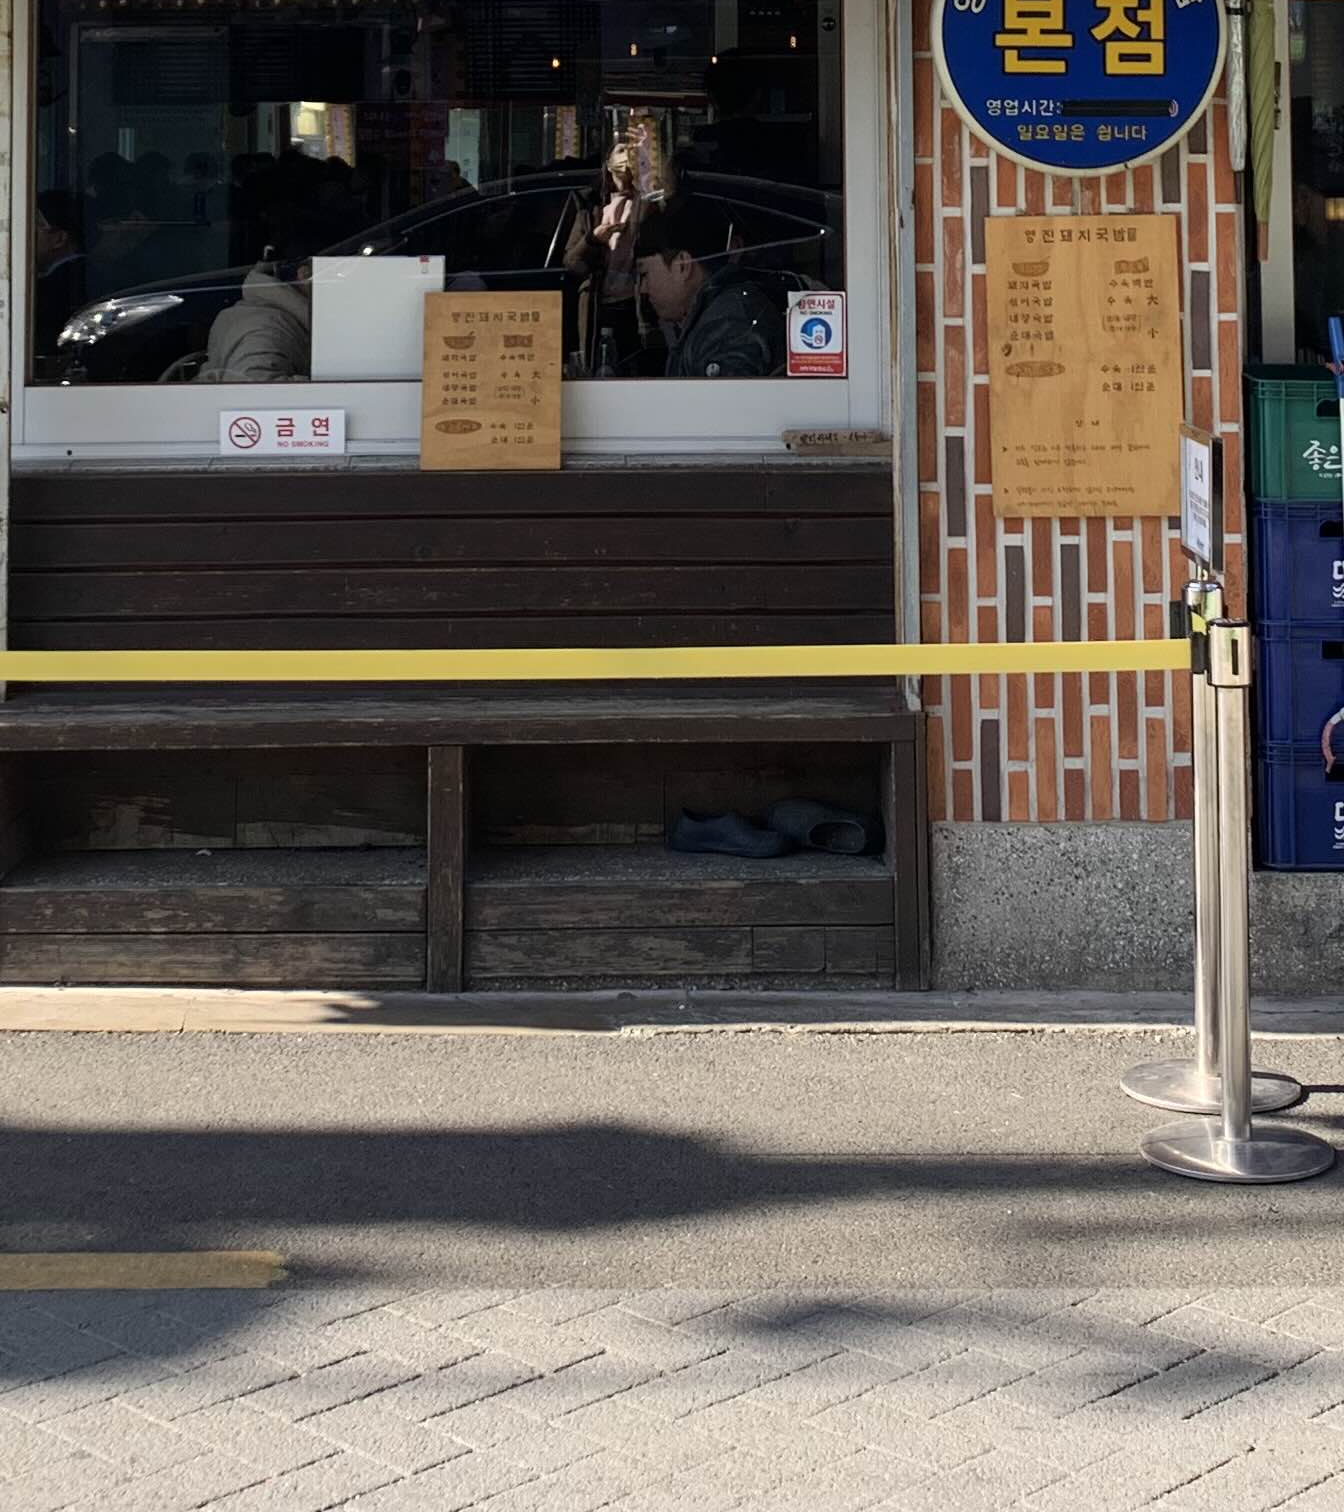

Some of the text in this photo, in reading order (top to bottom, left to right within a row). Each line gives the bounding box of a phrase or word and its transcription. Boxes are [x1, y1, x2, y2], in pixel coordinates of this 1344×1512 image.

[1017, 124, 1148, 141] 일요일은 쉽니다
[1024, 228, 1126, 244] 영진돼지국밥
[275, 417, 329, 437] 금연
